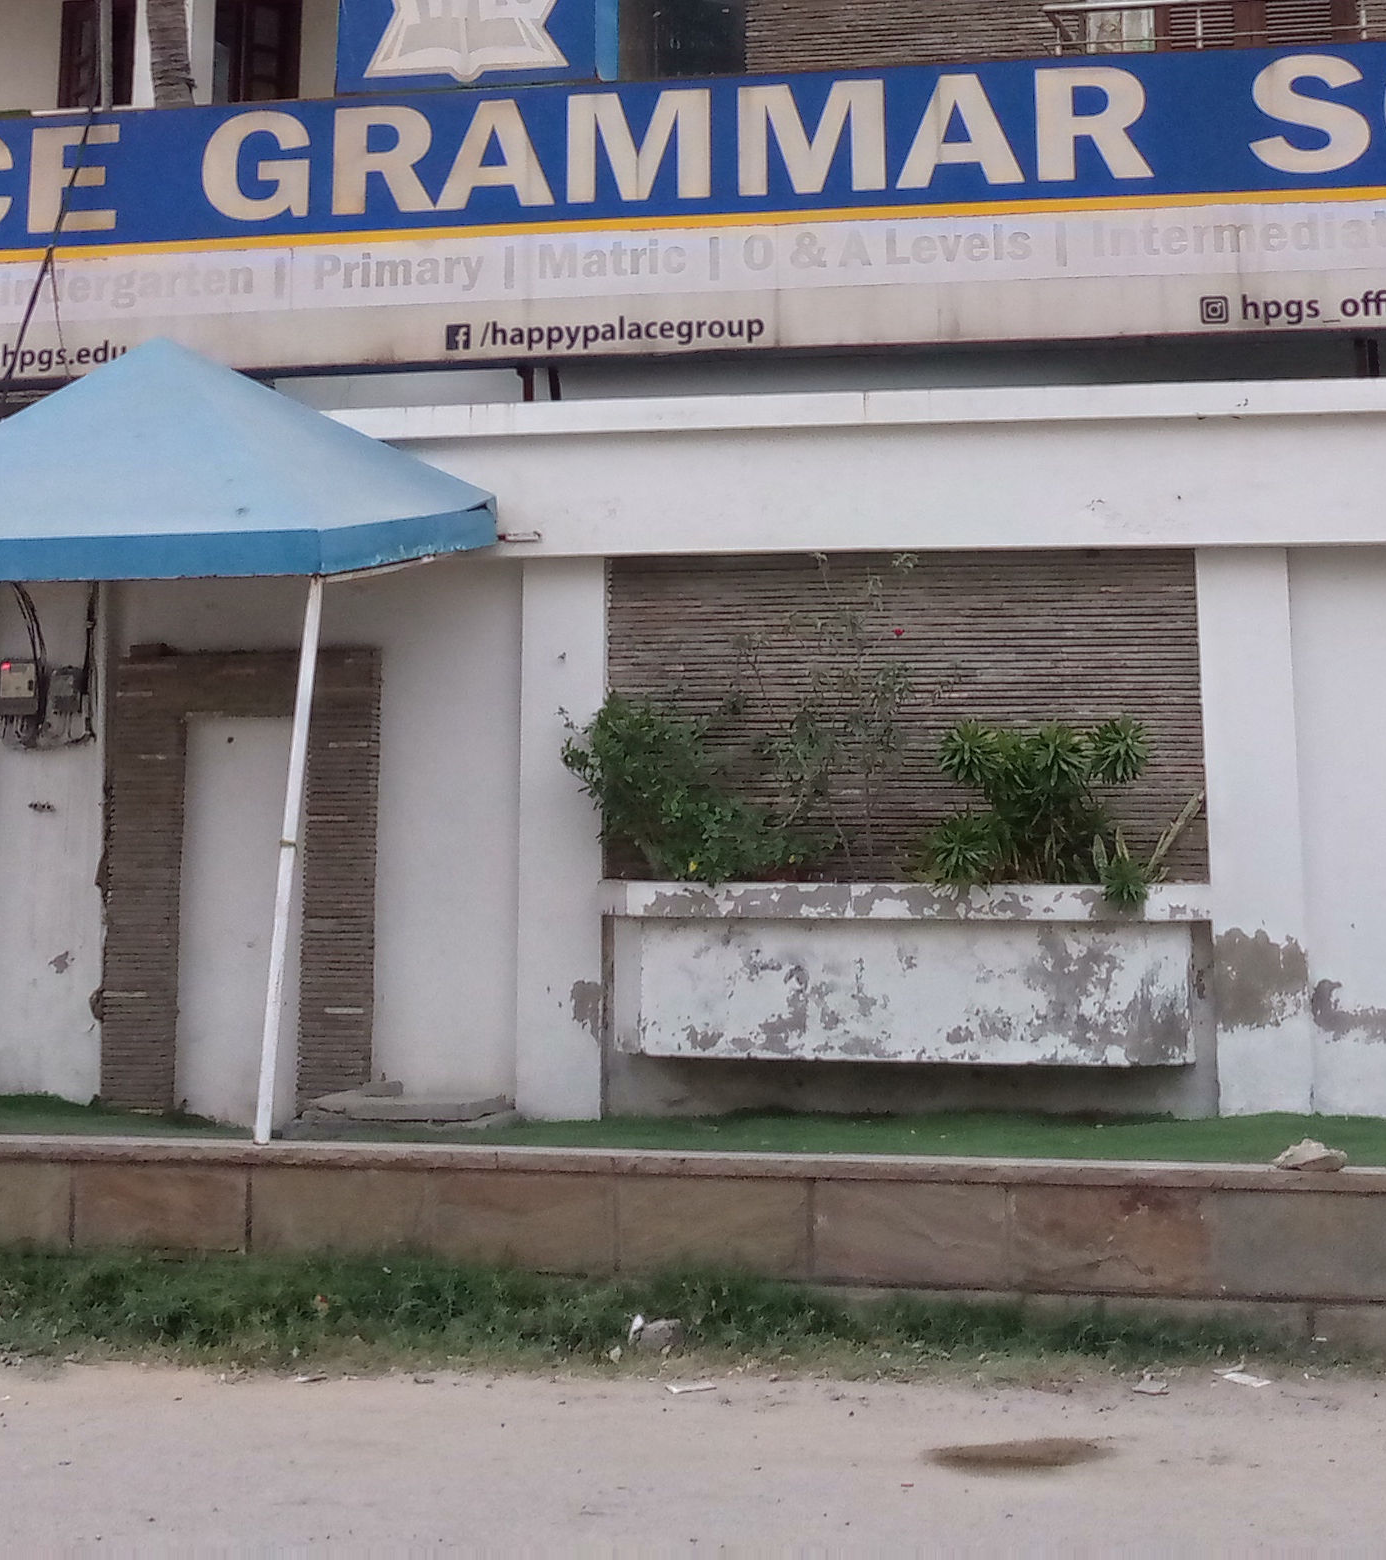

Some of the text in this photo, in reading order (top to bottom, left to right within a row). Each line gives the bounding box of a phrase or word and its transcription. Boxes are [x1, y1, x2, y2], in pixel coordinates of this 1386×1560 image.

[201, 65, 1155, 222] GRAMMAR
[314, 250, 485, 291] Primary
[538, 240, 687, 281] Matric
[789, 231, 827, 269] &
[837, 229, 873, 268] A
[885, 223, 1033, 265] Levels
[480, 315, 765, 350] /happypalacegroup
